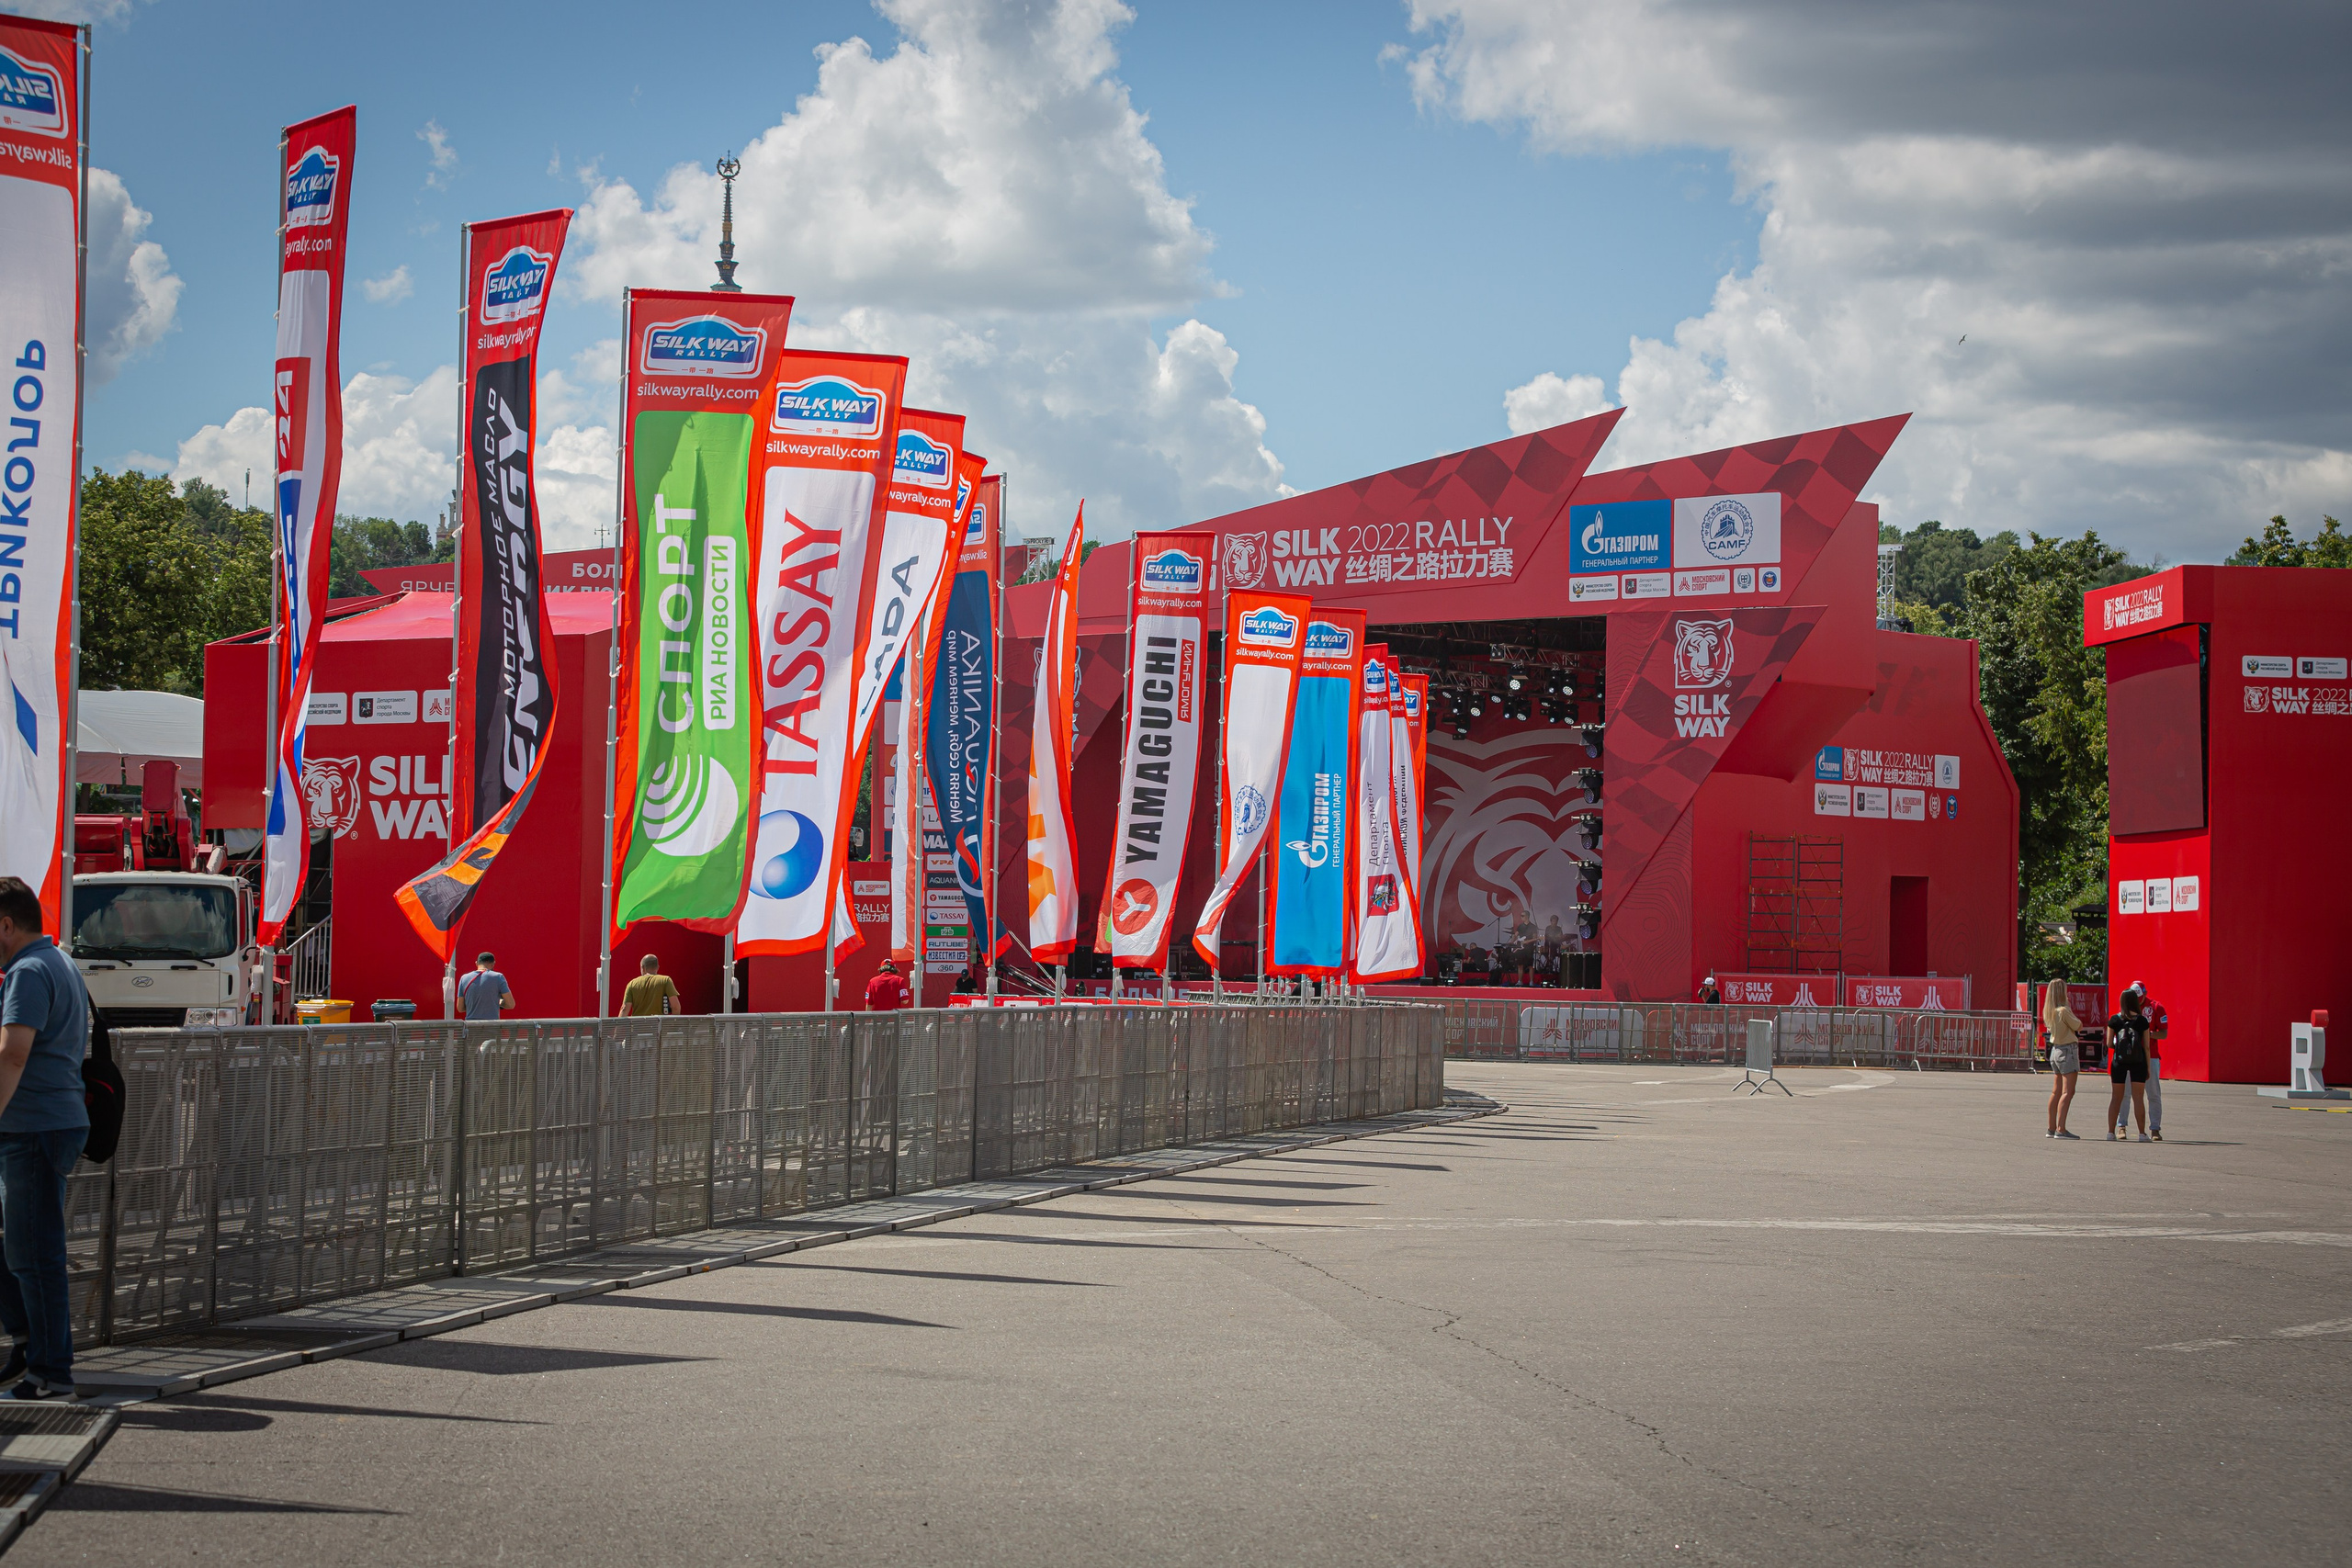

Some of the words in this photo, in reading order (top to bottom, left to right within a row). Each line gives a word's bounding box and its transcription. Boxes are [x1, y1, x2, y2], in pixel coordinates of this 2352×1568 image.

[489, 274, 518, 295] SILK
[652, 334, 706, 351] SILK
[707, 337, 755, 353] WAY
[674, 349, 729, 358] RALLY
[637, 382, 760, 401] silkwayrally.com
[780, 396, 830, 412] SILK
[831, 399, 876, 413] WAY
[801, 410, 852, 420] RALLY
[484, 387, 499, 507] МАСЛО
[766, 441, 881, 459] silkwayrally.com
[914, 450, 945, 467] WAY
[1272, 527, 1341, 558] SILK
[1347, 521, 1410, 554] 2022
[1415, 516, 1513, 550] RALLY
[1604, 534, 1659, 554] ГАЗПРОМ
[1708, 539, 1746, 550] CAMF
[1147, 564, 1175, 575] SILK
[1175, 565, 1198, 575] WAY
[1344, 547, 1514, 584] 丝绸之路拉力赛
[1582, 557, 1629, 569] ГЕНЕРАЛЬНЫЙ
[1629, 555, 1659, 565] ПАРТНЕР
[1272, 558, 1341, 588] WAY
[1691, 572, 1725, 583] МОСКОВСКИЙ
[1691, 583, 1708, 592] СПОРТ
[492, 514, 517, 700] МОТОРНОЕ
[711, 544, 729, 667] НОВОСТИ
[1137, 596, 1202, 610] silkwayrally.com
[2115, 594, 2131, 613] SILK
[2131, 591, 2143, 609] 2022
[2143, 584, 2164, 604] RALLY
[655, 493, 696, 734] СПОРТ
[2115, 611, 2130, 628] WAY
[1246, 619, 1269, 628] SILK
[1269, 621, 1292, 631] WAY
[1320, 634, 1347, 643] WAY
[762, 508, 842, 795] TASSAY
[710, 669, 728, 720] РИА
[2271, 687, 2311, 701] SILK
[2312, 688, 2347, 702] 2022
[1674, 694, 1731, 716] SILK
[2271, 701, 2311, 715] WAY
[2312, 701, 2352, 716] 丝绸之
[1674, 716, 1731, 738] WAY
[1125, 636, 1178, 864] YAMAGUCHI
[1860, 749, 1883, 766] SILK
[1884, 751, 1905, 768] 2022
[1905, 753, 1934, 770] RALLY
[1860, 766, 1883, 783] WAY
[1333, 773, 1342, 809] ПАРТНЕР
[1311, 773, 1330, 840] ГАЗПРОМ
[368, 799, 448, 840] WA
[1332, 809, 1340, 868] ГЕНЕРАЛЬНЫЙ
[854, 903, 890, 913] RALLY
[928, 951, 956, 960] ИЗВЕСТИЯ
[1746, 982, 1773, 993] SILK
[1875, 986, 1902, 997] SILK
[1746, 992, 1773, 1003] WAY
[1875, 996, 1903, 1007] WAY
